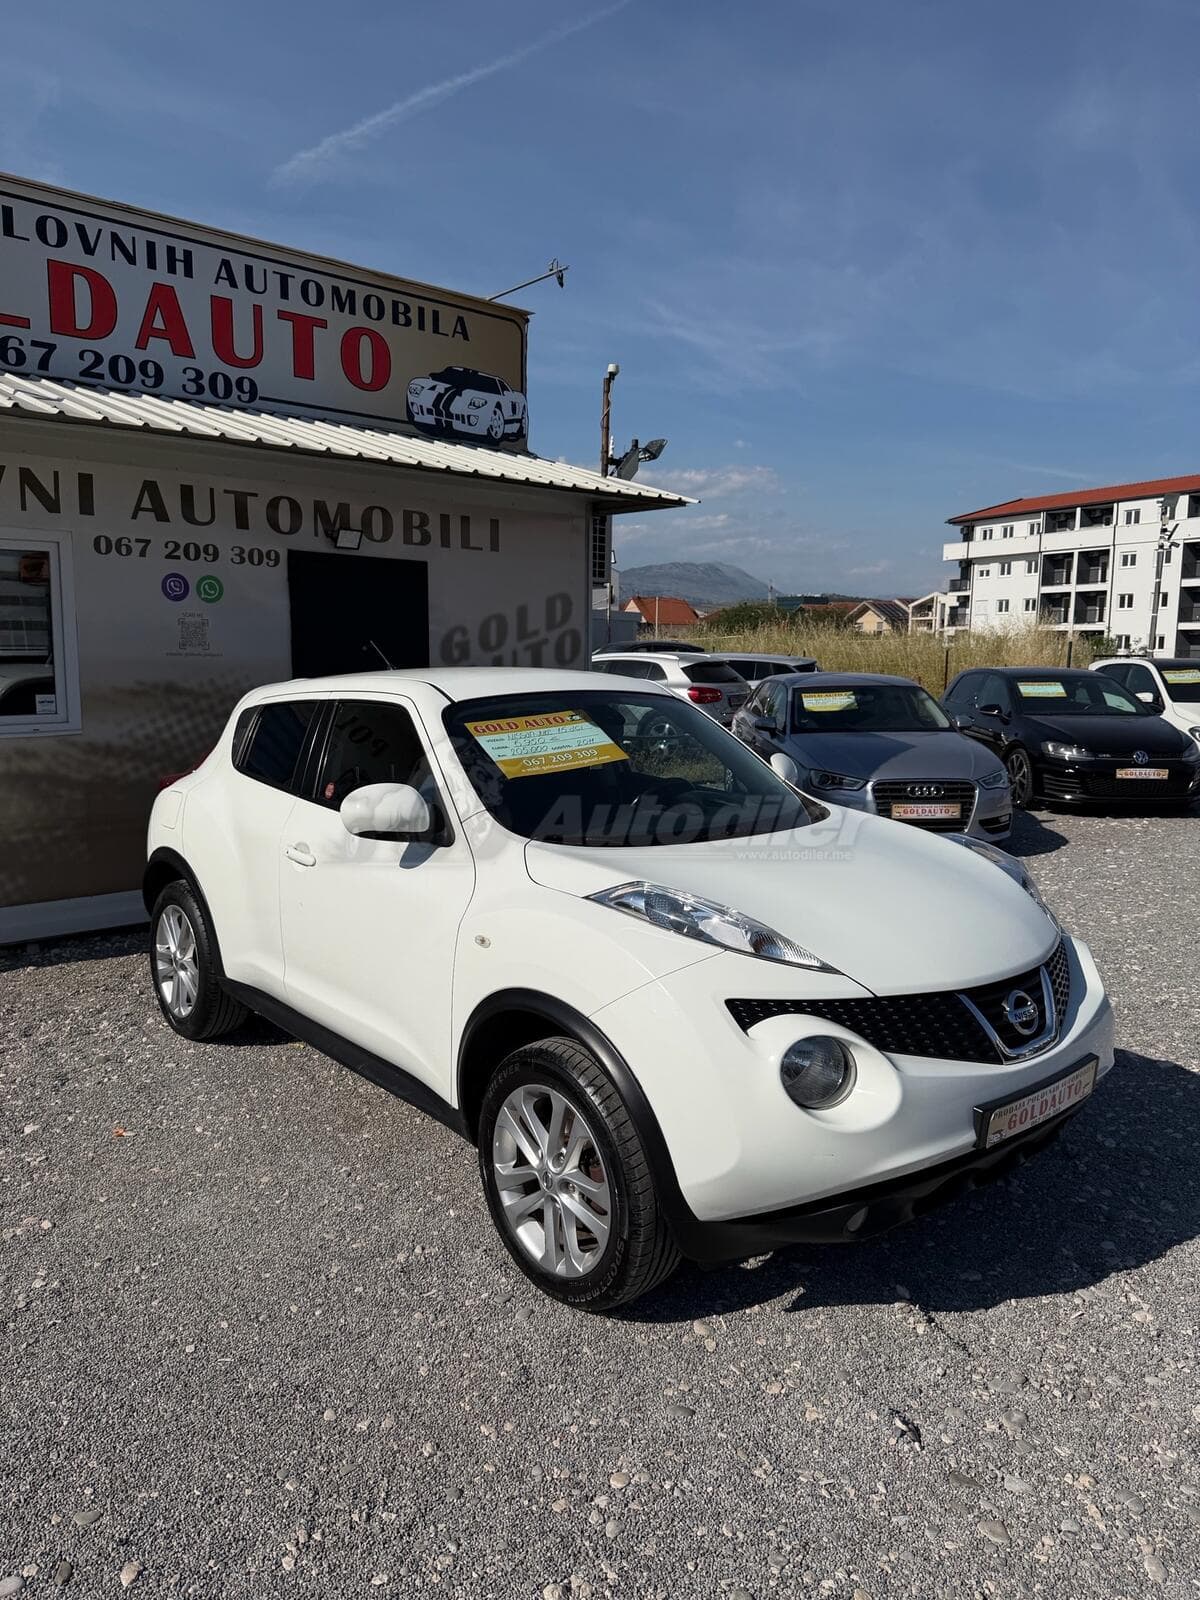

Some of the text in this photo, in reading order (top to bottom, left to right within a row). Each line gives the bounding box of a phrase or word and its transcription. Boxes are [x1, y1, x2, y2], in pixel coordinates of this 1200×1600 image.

[2, 205, 470, 342] LOVNIH AUTOMOBILA
[78, 349, 165, 389] 209
[181, 367, 259, 404] 309
[0, 465, 500, 552] NI AUTOMOBILI
[93, 535, 281, 568] 067 209 309
[439, 592, 574, 665] GOLD
[473, 715, 565, 734] GOLD AUTO
[522, 757, 545, 767] 067
[551, 752, 573, 763] 209
[574, 749, 598, 759] 309
[1008, 1080, 1082, 1131] GOLDAUTO
